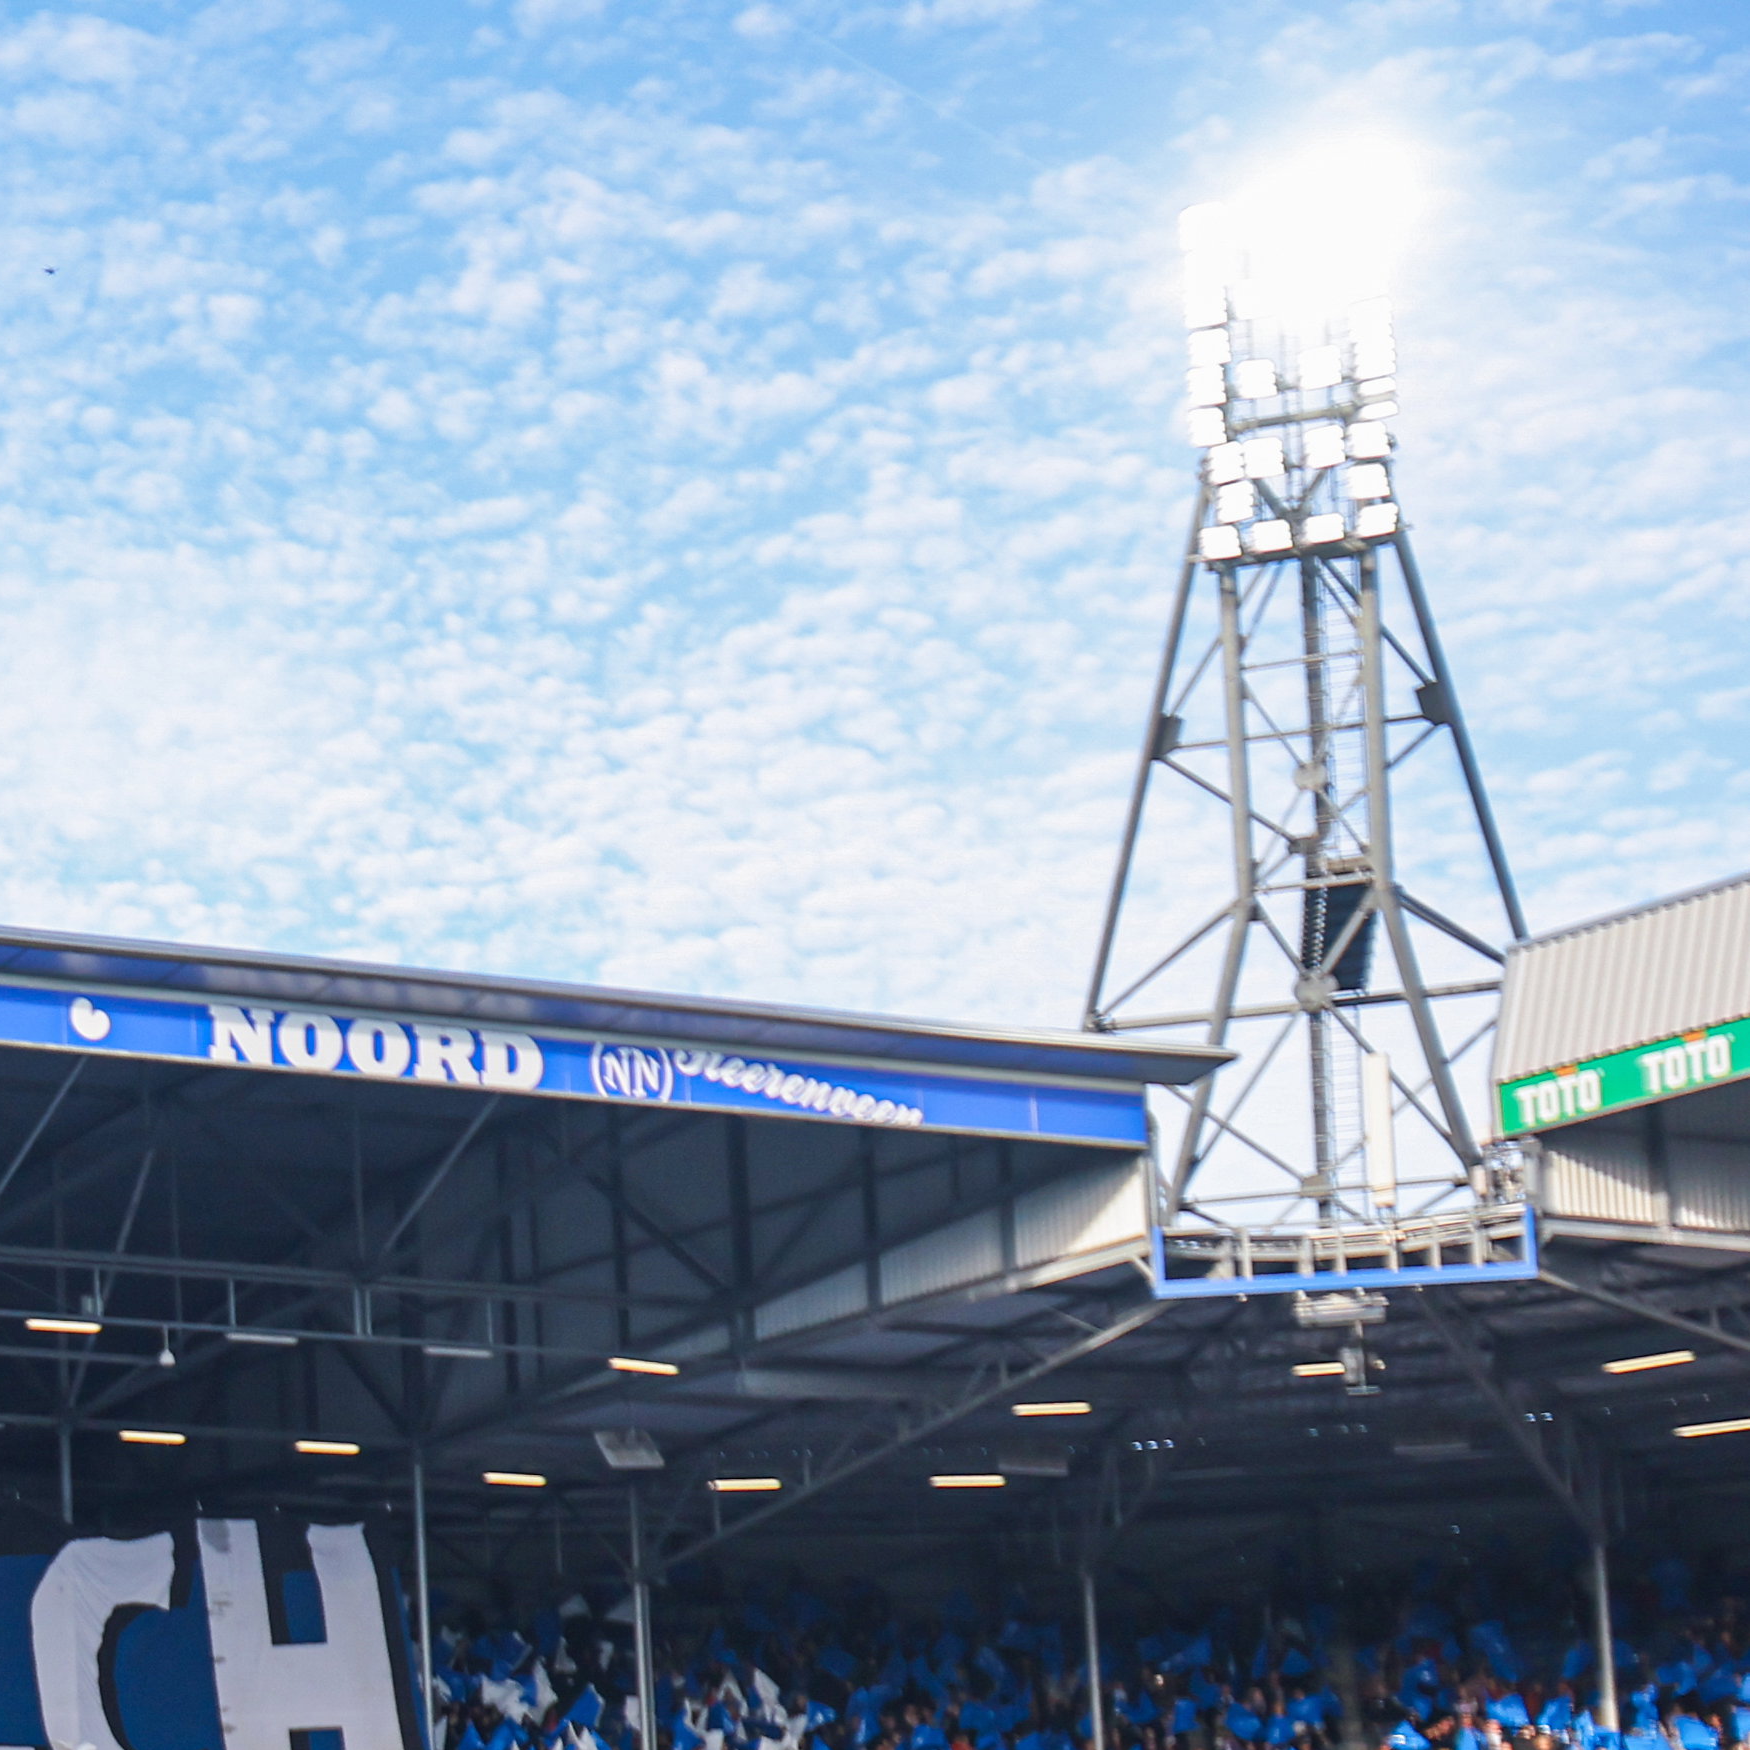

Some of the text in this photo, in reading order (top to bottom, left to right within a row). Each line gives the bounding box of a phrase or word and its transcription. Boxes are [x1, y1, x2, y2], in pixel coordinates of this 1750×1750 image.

[209, 1003, 545, 1091] NOORD
[1514, 1033, 1731, 1127] TOTO TOTO
